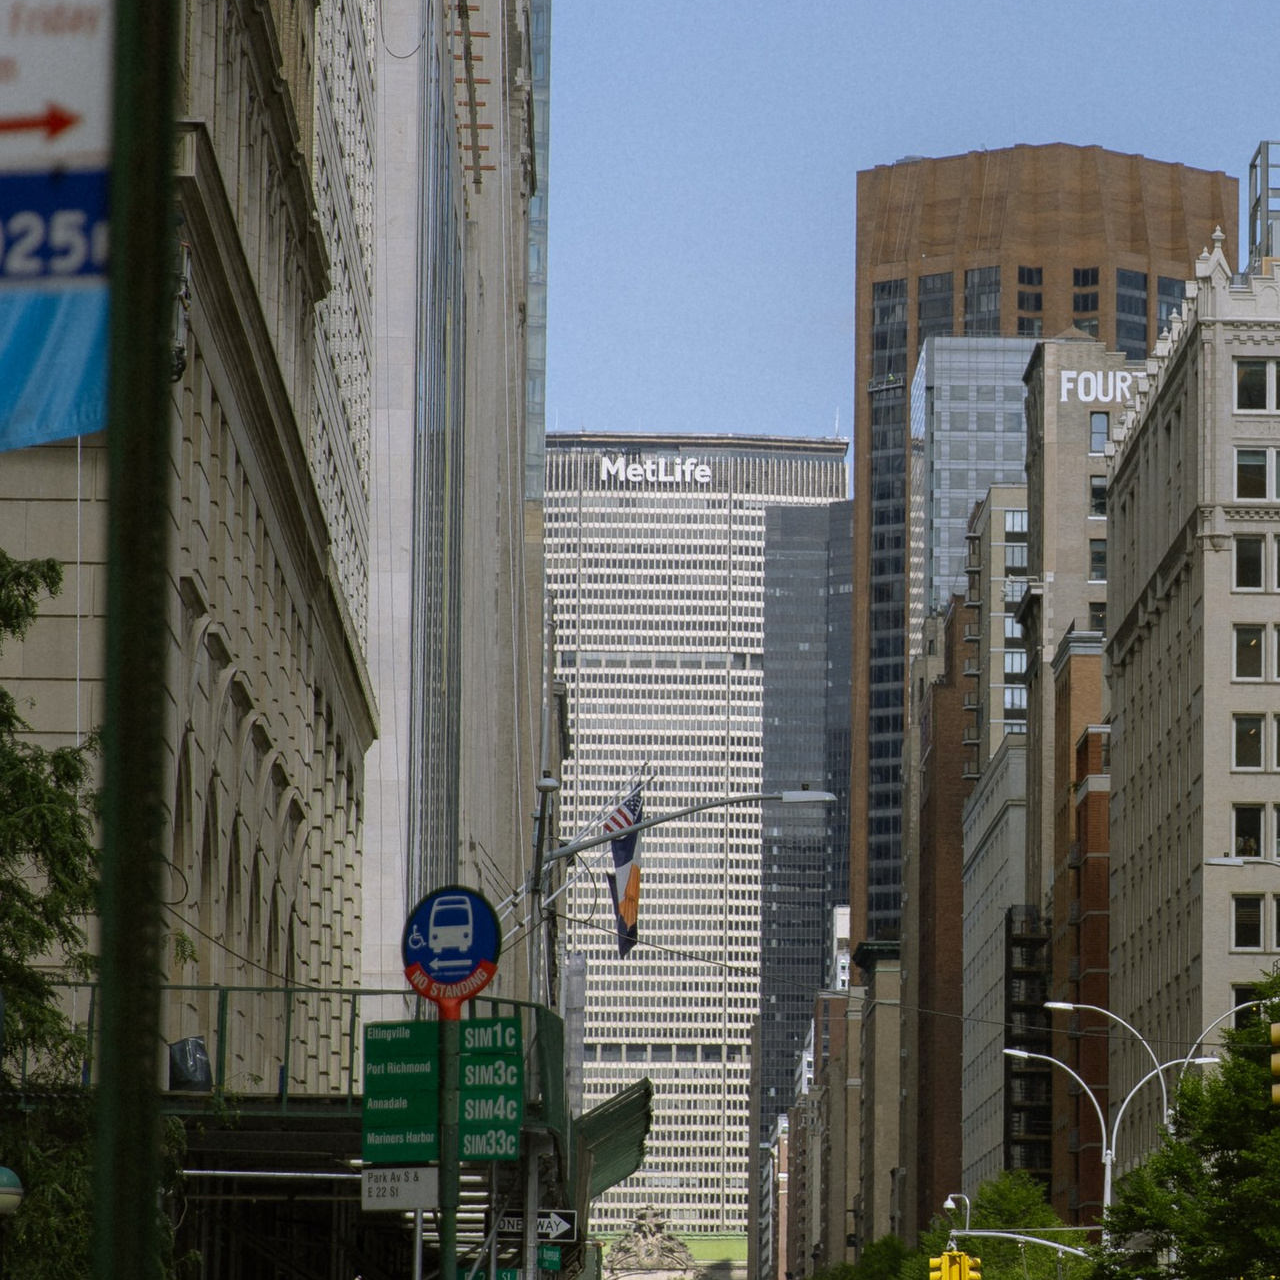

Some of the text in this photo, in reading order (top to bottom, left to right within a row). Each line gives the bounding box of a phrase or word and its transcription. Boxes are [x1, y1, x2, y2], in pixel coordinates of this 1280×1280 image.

[600, 456, 712, 484] MetLife
[411, 968, 488, 997] NO STANDING
[367, 1027, 410, 1041] Eltingville
[366, 1061, 431, 1075] Port Richmond
[367, 1097, 408, 1110] Annadale
[367, 1131, 435, 1144] Mariners Harbor
[367, 1170, 420, 1184] Park Av S &
[367, 1185, 399, 1198] E 22 St
